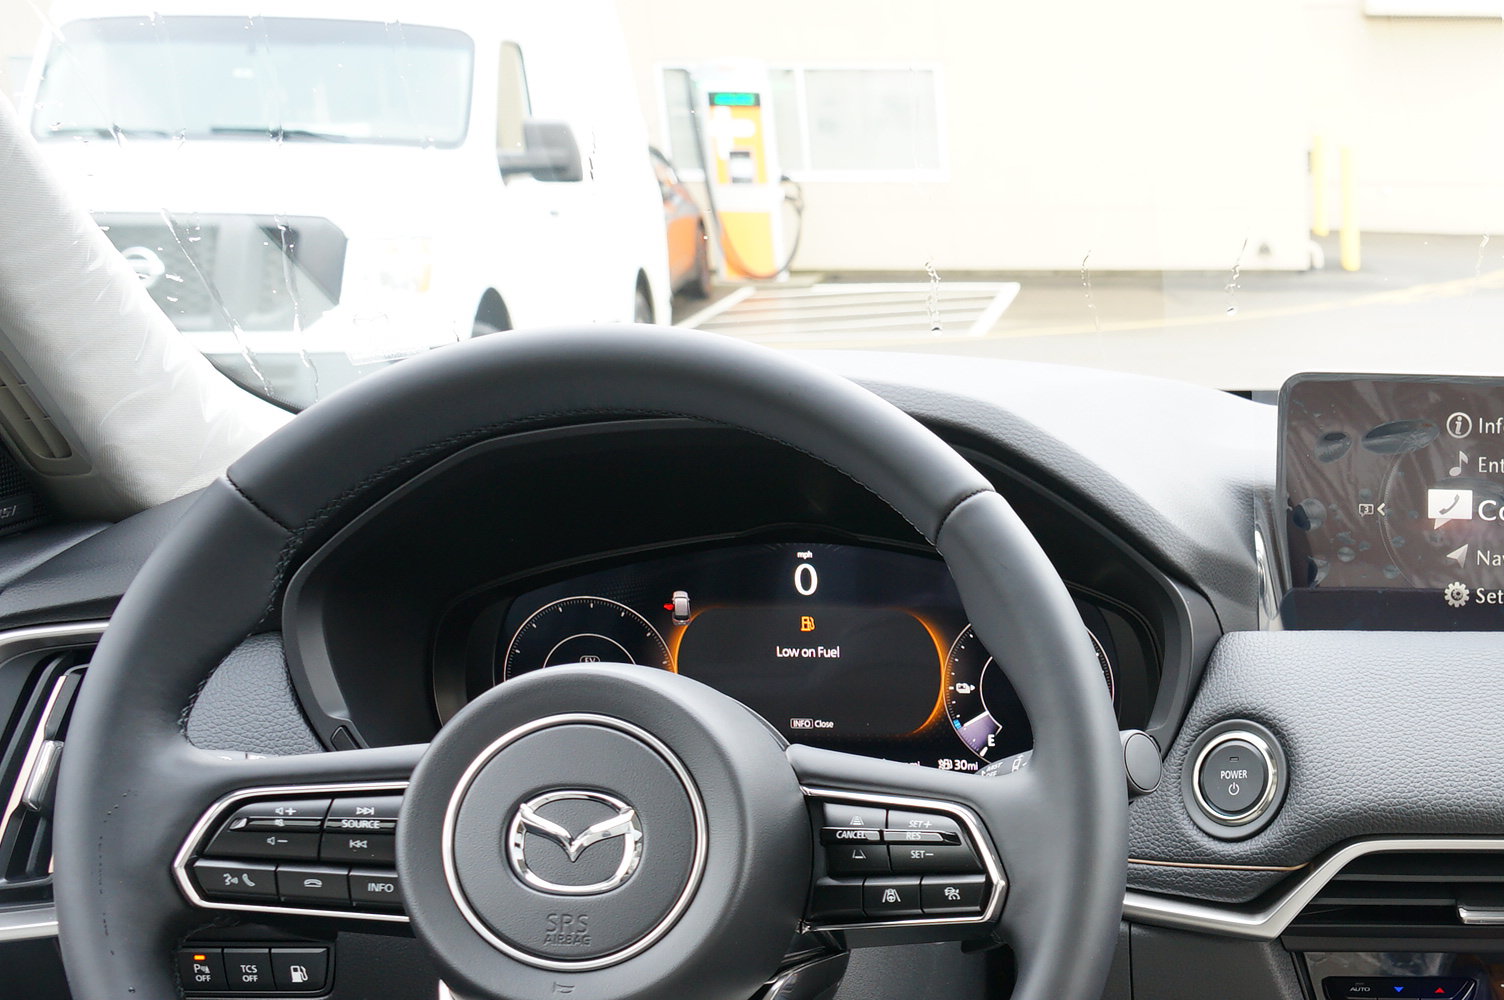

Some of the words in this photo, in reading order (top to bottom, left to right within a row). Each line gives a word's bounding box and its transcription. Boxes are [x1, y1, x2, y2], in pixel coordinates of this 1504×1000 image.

[797, 550, 813, 560] mph
[794, 563, 818, 596] 0
[776, 645, 799, 660] Low
[801, 648, 815, 660] on
[817, 645, 840, 660] Fuel
[792, 719, 812, 729] INFO
[814, 718, 834, 730] Close
[987, 734, 996, 747] E
[1220, 769, 1247, 780] POWER
[341, 819, 381, 829] SOURCE
[836, 830, 867, 840] CANCEL
[906, 831, 922, 841] RES
[367, 882, 394, 893] INFO
[545, 913, 589, 936] SRS
[543, 935, 592, 947] AIRBAG
[240, 964, 258, 974] TCS
[195, 974, 211, 983] OFF
[242, 974, 259, 983] OFF
[1350, 985, 1371, 993] AUTO
